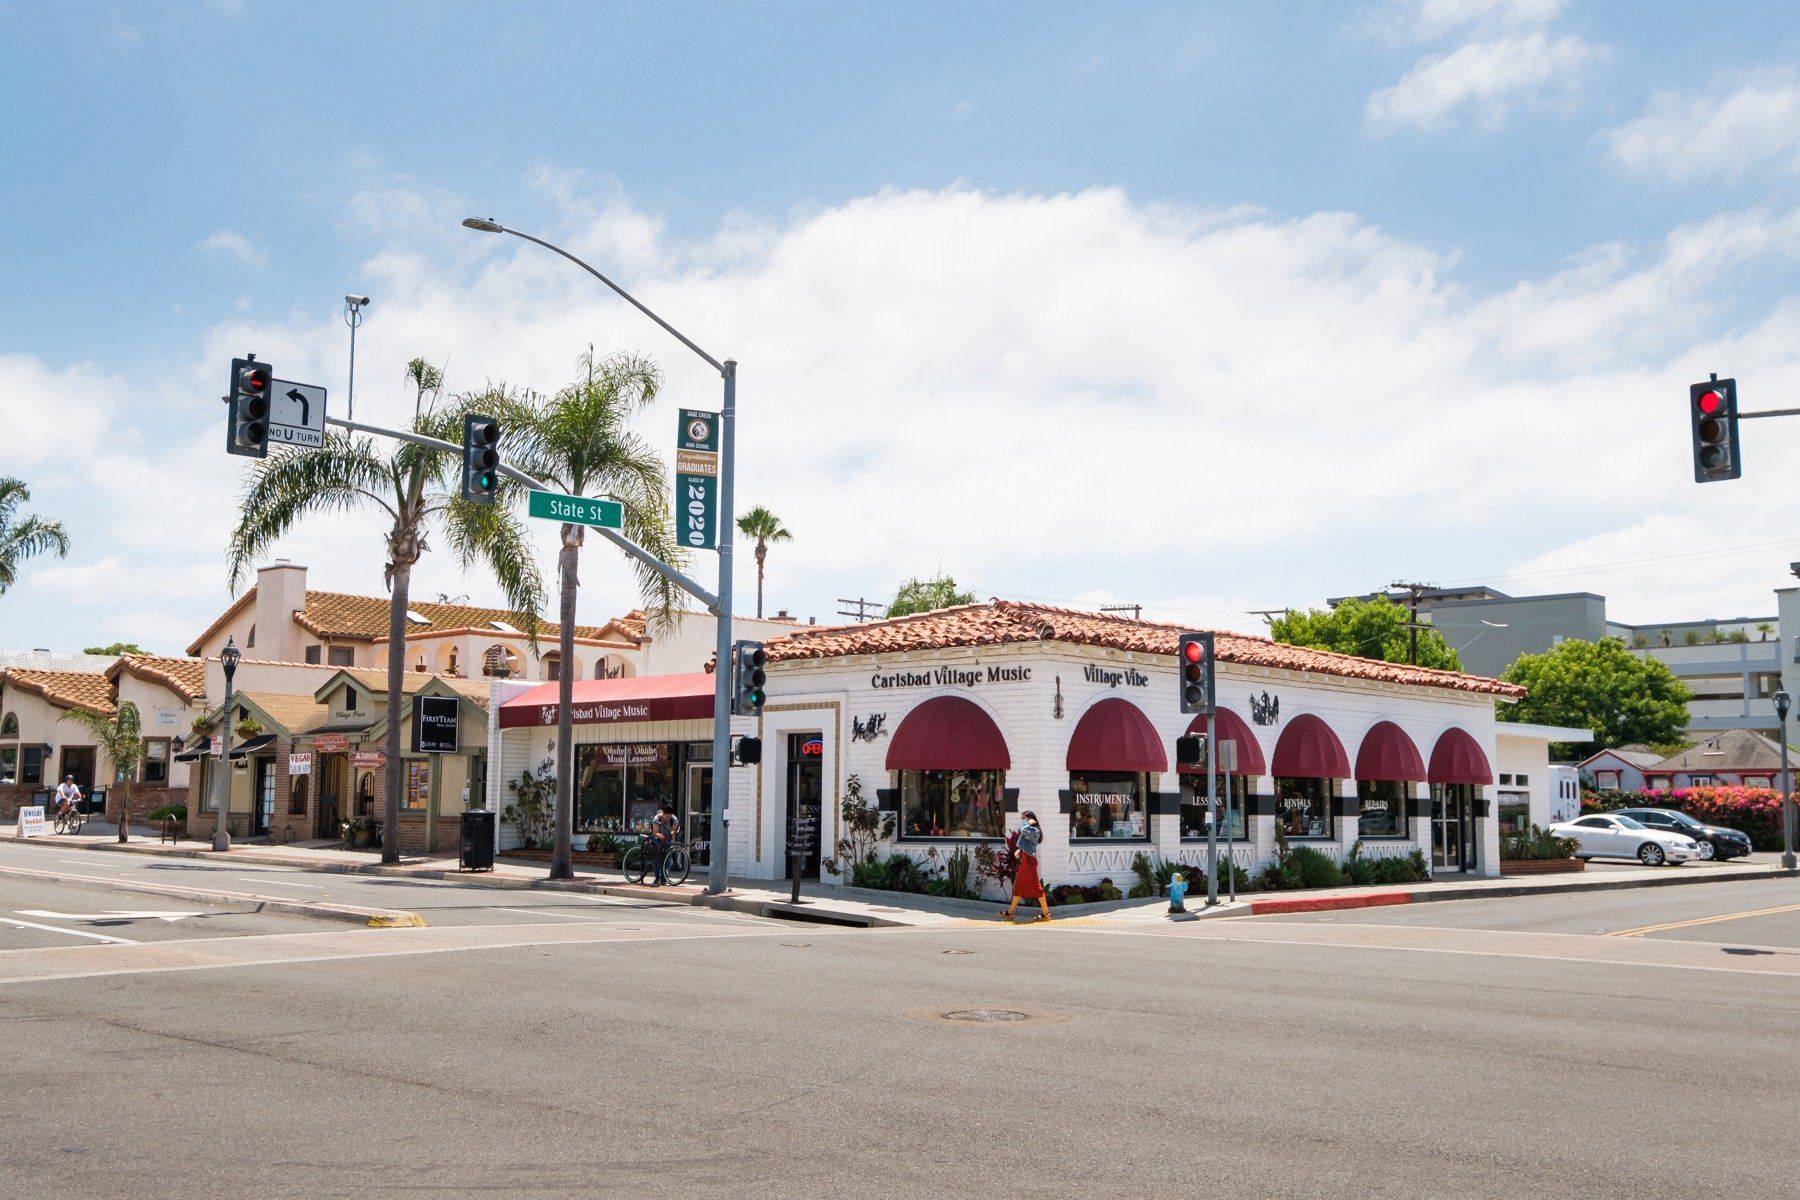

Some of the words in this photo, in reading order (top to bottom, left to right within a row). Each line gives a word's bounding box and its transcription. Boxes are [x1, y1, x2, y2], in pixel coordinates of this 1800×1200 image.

[269, 428, 281, 437] NO
[284, 428, 293, 440] U
[297, 432, 320, 443] TURN
[677, 462, 717, 474] GRADUATES
[550, 500, 584, 518] State
[590, 506, 602, 521] St
[688, 484, 705, 546] 2020
[871, 671, 931, 688] Carlsbad
[934, 665, 983, 688] Village
[987, 665, 1032, 683] Music
[1083, 663, 1123, 688] Village
[1125, 667, 1149, 687] Vibe
[571, 708, 593, 720] lsbad
[595, 704, 622, 720] Village
[623, 704, 648, 717] Music
[290, 753, 311, 763] VEGAS
[607, 754, 626, 763] Music
[1076, 793, 1131, 806] INSTRUMENTS
[1192, 796, 1223, 806] LESSNS
[1284, 798, 1311, 810] RENTALS
[1365, 799, 1389, 808] REPAIRS
